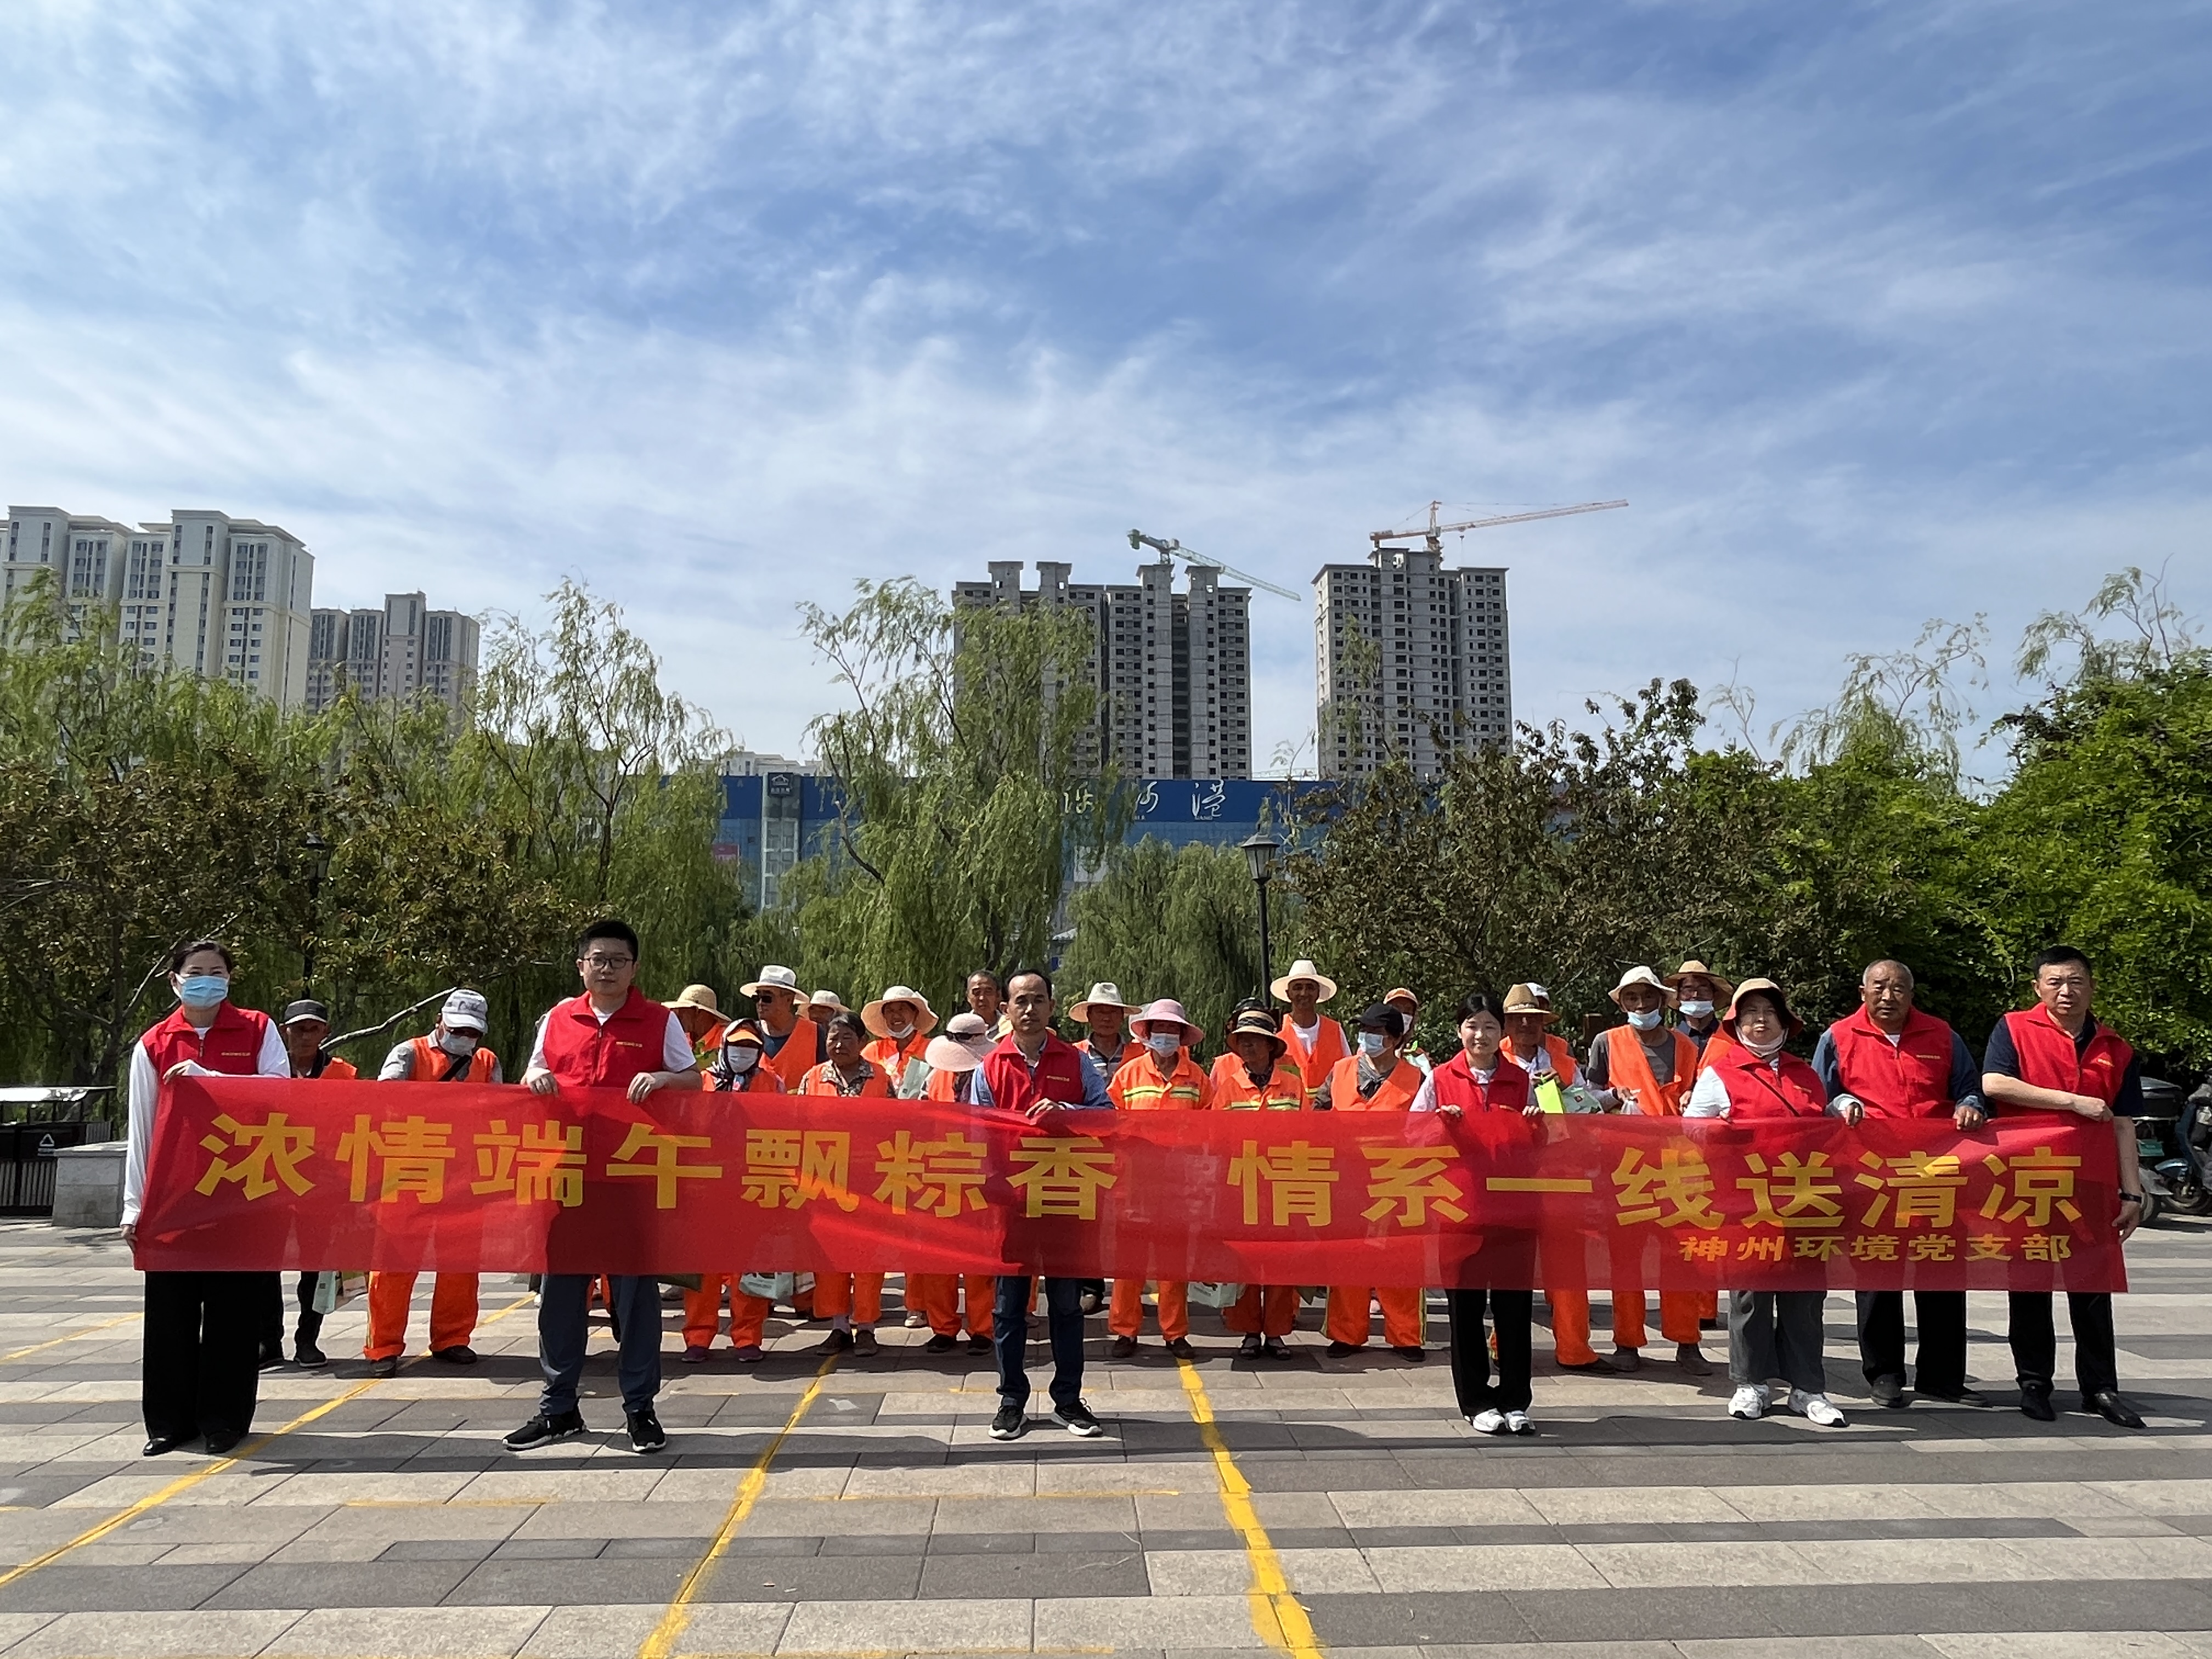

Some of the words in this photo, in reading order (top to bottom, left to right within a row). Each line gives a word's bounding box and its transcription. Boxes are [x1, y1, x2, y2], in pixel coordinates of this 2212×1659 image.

[194, 1113, 1117, 1220] 浓情端午飘粽香
[1226, 1140, 2082, 1230] 情系一线送清凉
[1679, 1234, 2073, 1263] 神州环境党支部
